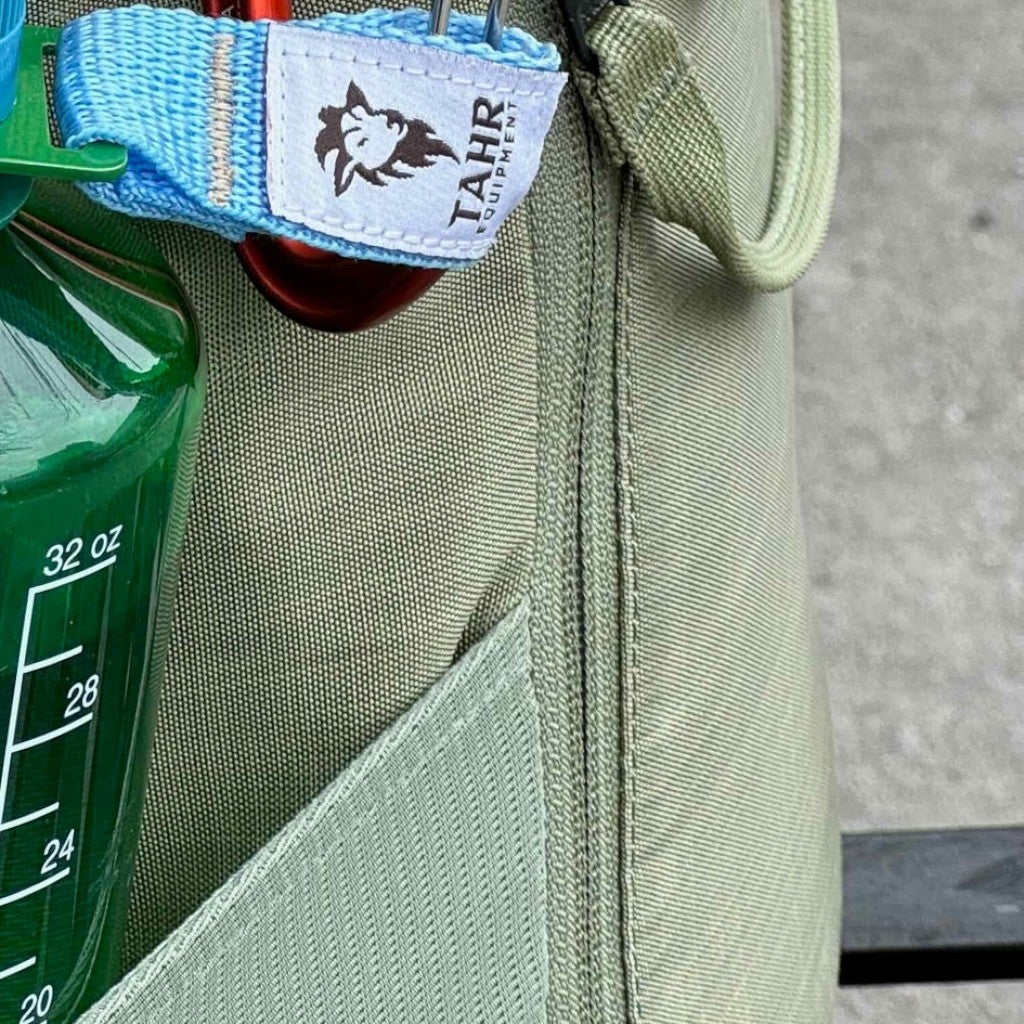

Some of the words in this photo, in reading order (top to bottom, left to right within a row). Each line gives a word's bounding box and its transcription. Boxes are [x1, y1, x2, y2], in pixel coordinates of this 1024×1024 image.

[447, 95, 505, 228] TAHR
[476, 100, 520, 235] EQUIPMENT
[41, 536, 84, 577] 32
[89, 523, 123, 559] oz
[62, 674, 100, 719] 28
[40, 828, 75, 875] 24
[18, 984, 54, 1024] 20
